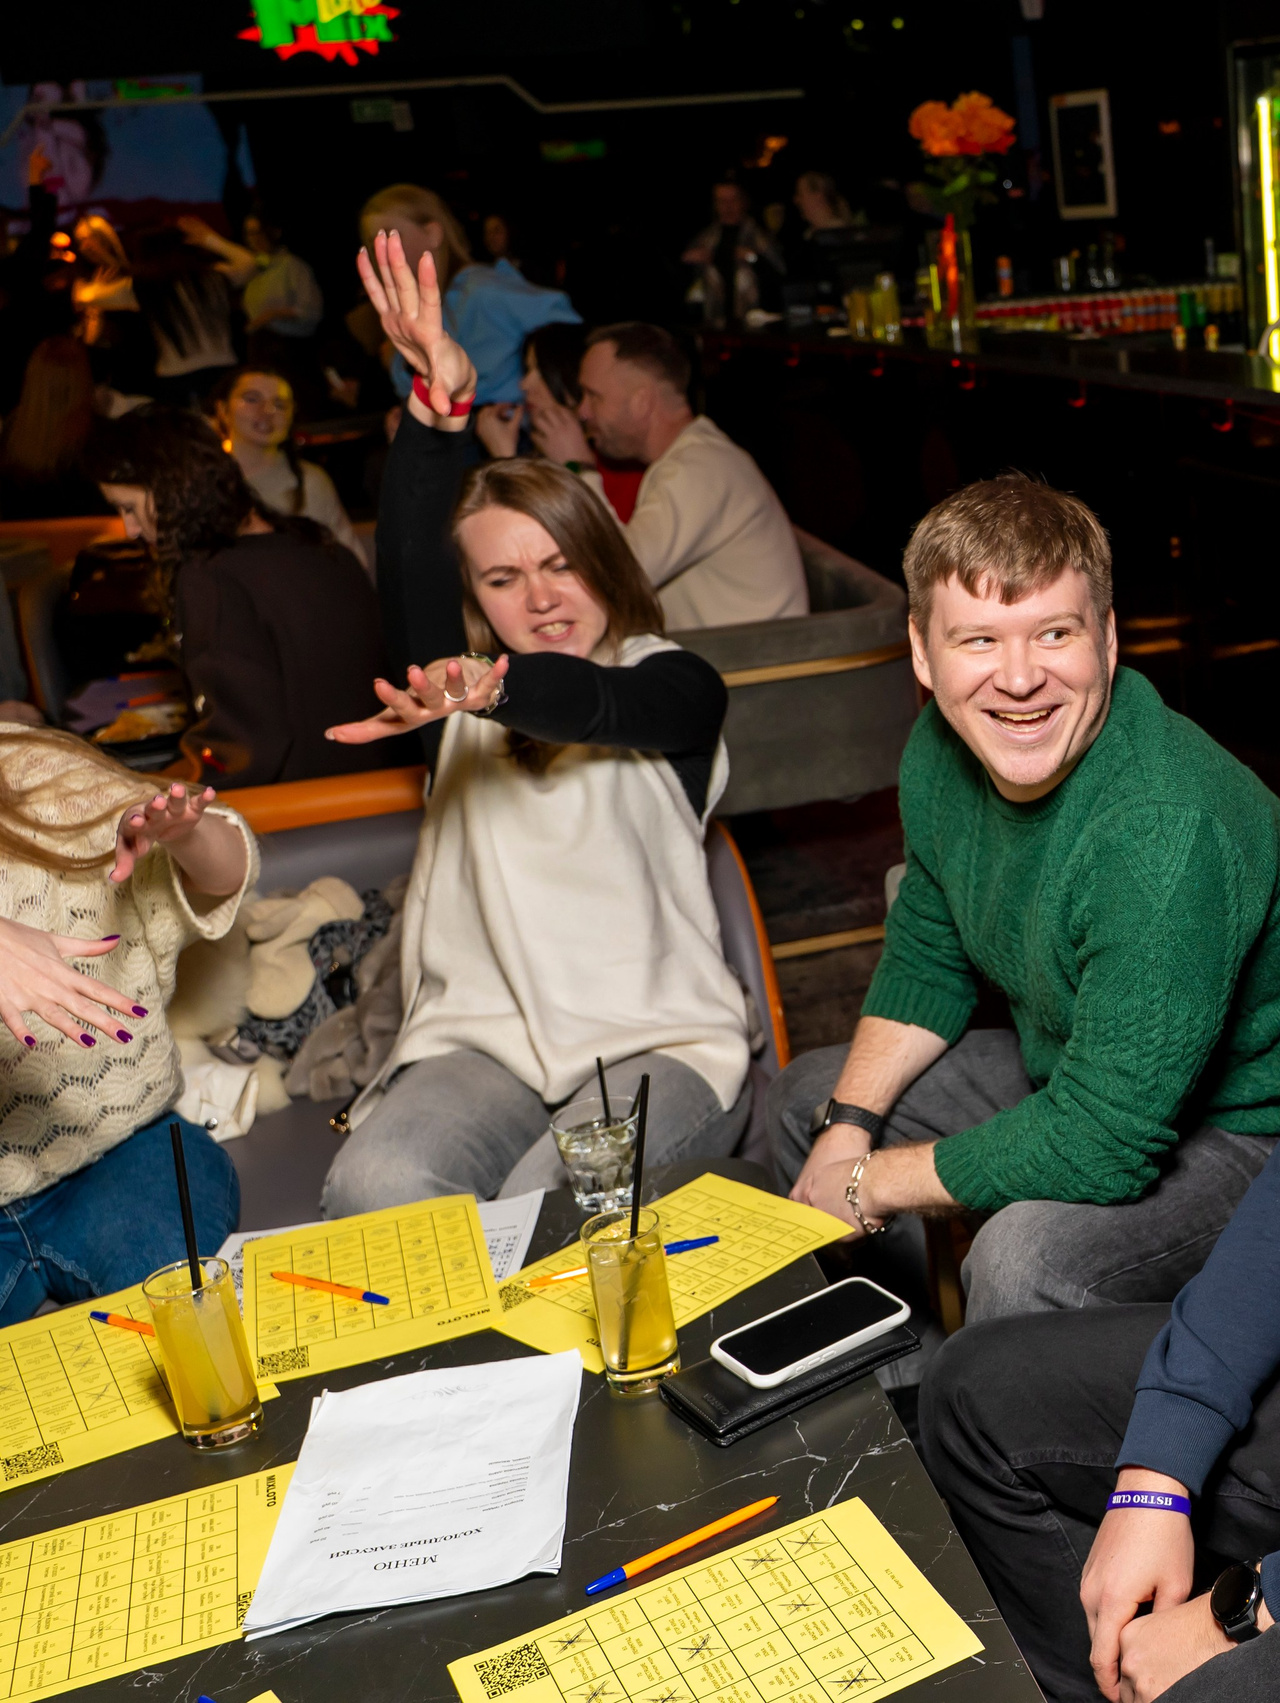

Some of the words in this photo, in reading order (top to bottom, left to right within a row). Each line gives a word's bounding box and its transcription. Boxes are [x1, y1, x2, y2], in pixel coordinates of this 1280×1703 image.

[265, 1474, 277, 1508] MIXLOTO
[400, 1526, 484, 1549] ХОЛОДНЫЕ
[329, 1544, 398, 1560] ЗАКУСКИ
[373, 1554, 439, 1571] МЕНЮ
